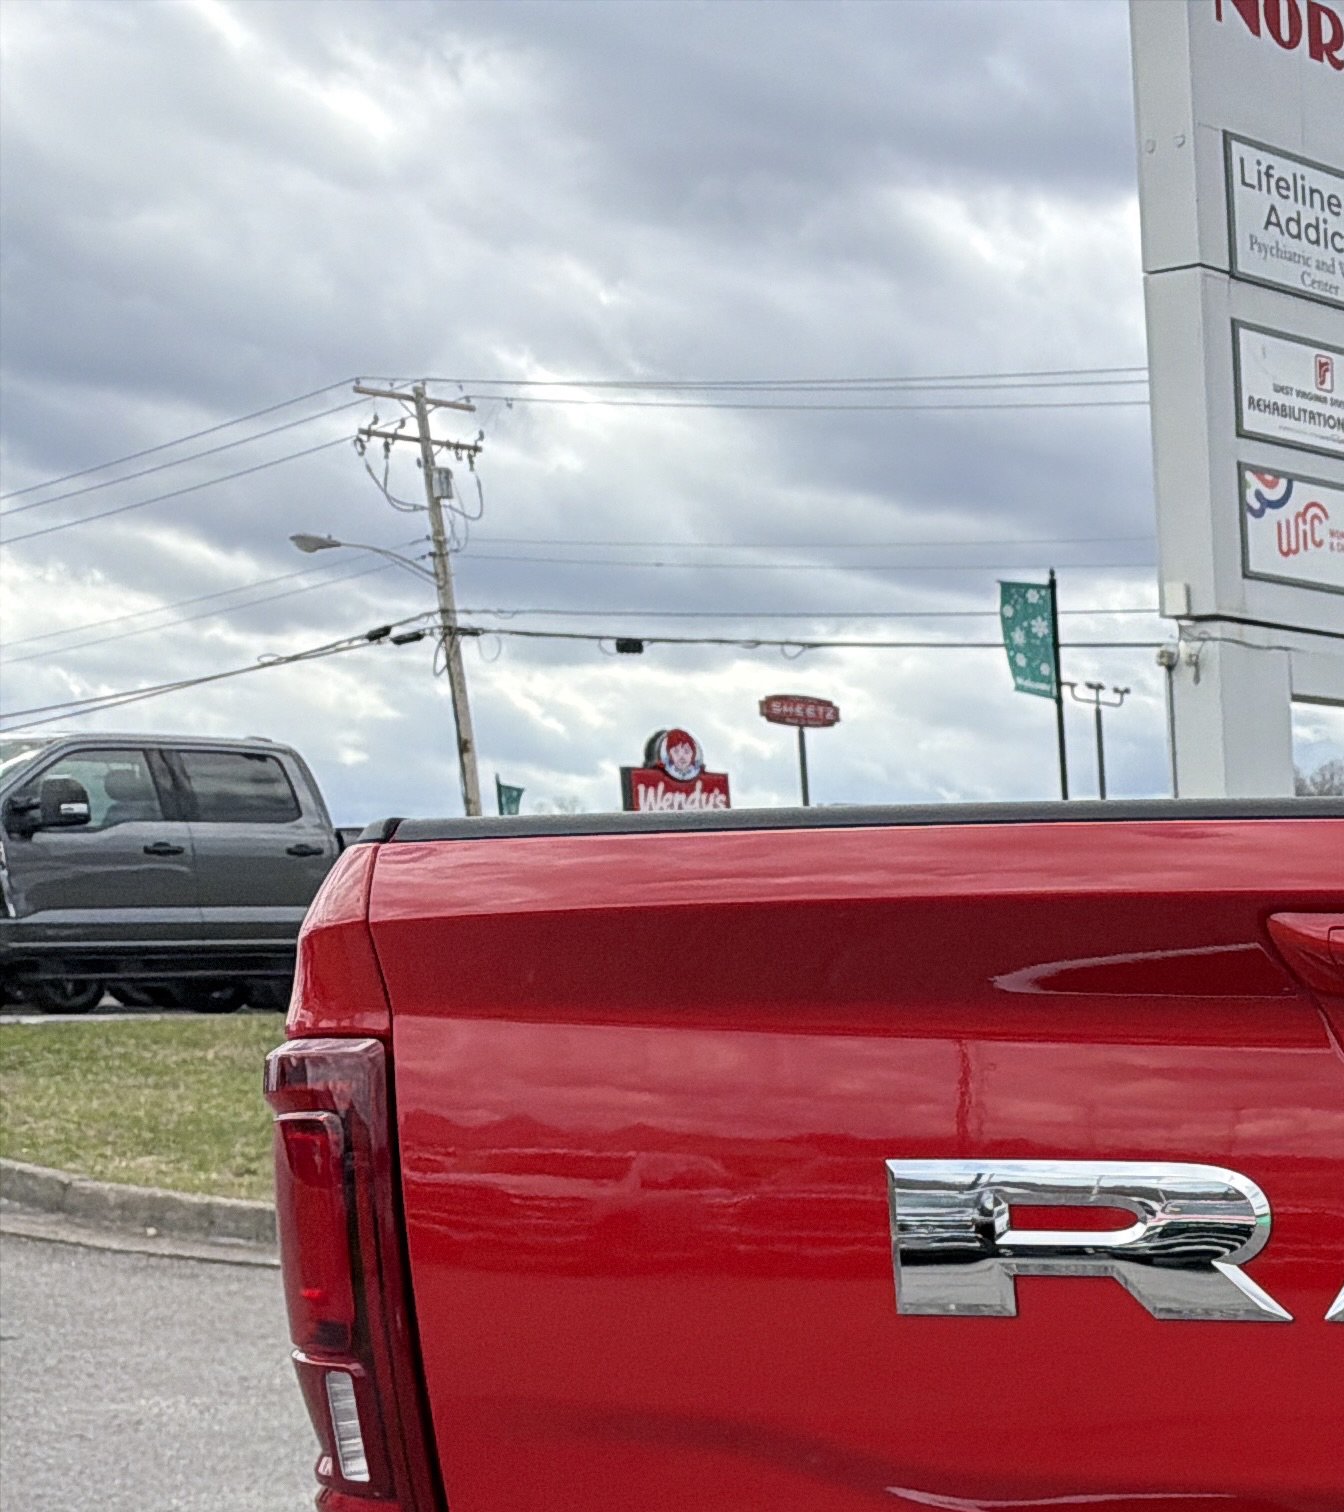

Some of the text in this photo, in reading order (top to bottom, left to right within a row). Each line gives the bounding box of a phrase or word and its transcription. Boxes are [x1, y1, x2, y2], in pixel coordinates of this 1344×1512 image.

[1239, 156, 1343, 217] Lifeline
[1249, 233, 1313, 269] Psychiatric
[1315, 257, 1336, 275] and
[1300, 270, 1340, 296] Center
[1272, 382, 1295, 398] WEST
[637, 780, 728, 812] Wendy's
